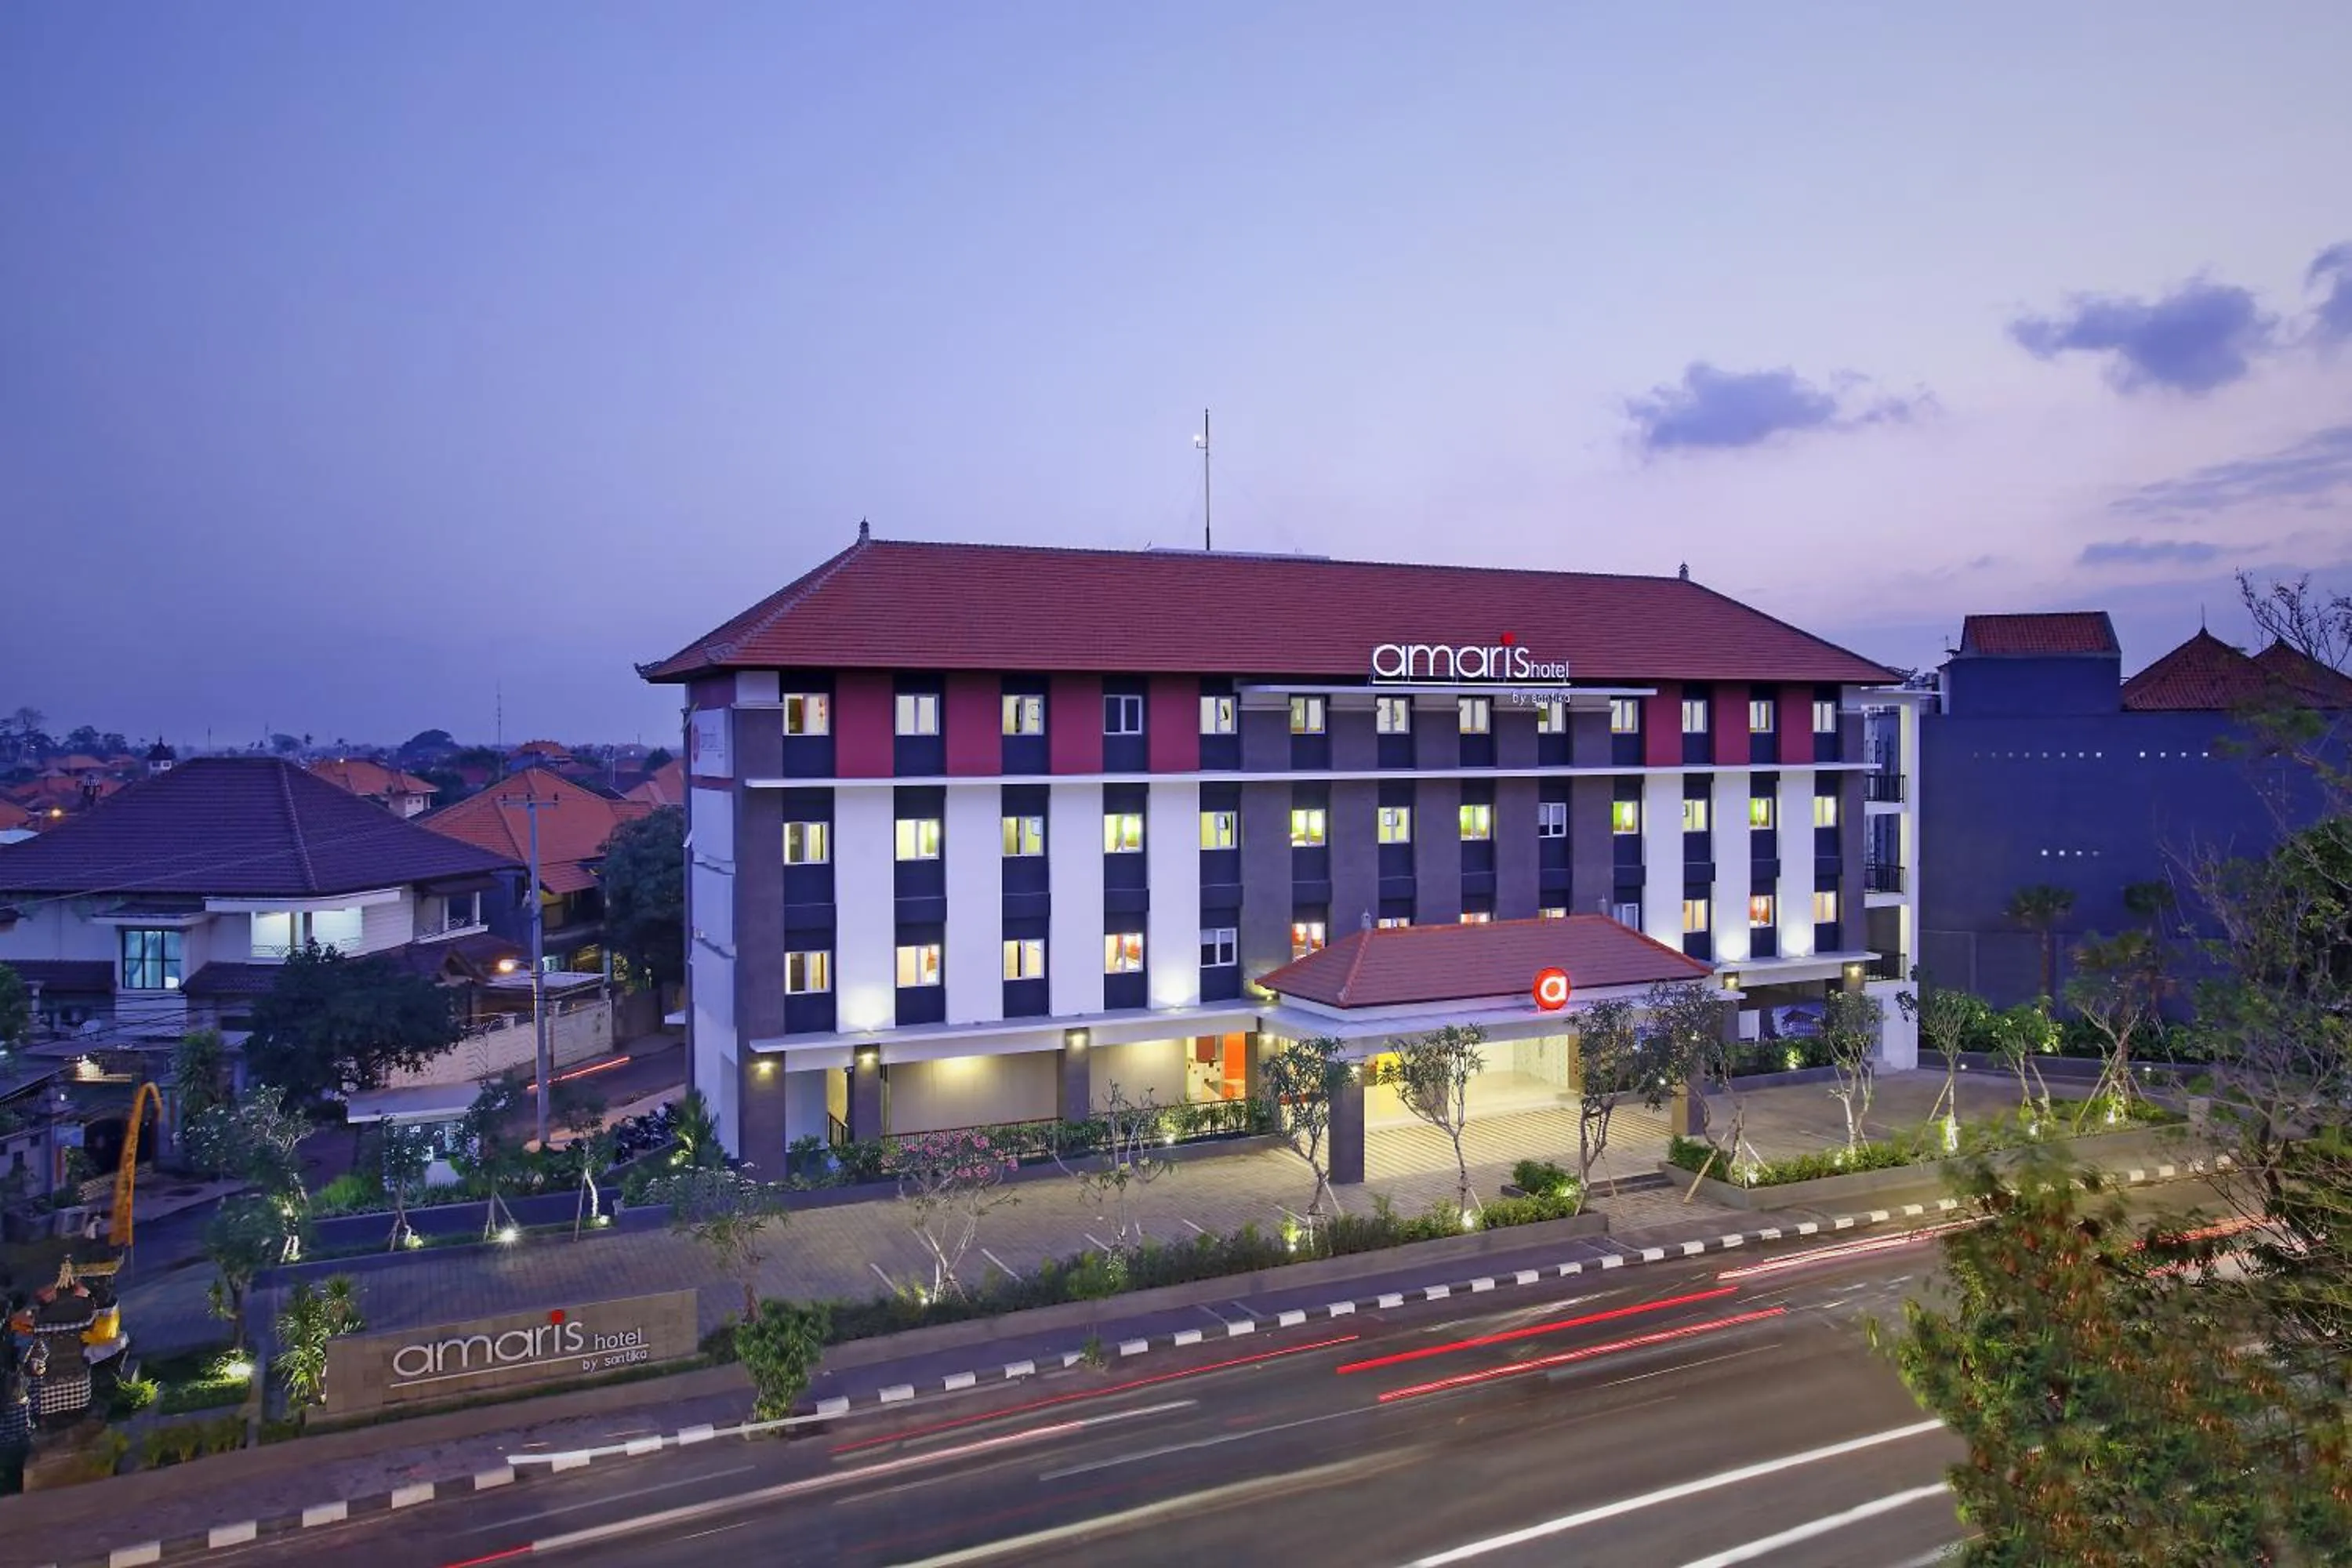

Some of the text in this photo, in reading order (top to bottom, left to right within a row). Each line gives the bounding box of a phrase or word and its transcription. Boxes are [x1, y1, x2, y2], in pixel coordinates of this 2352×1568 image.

[1373, 631, 1569, 678] amaris hotel
[1512, 691, 1526, 706] by
[393, 1309, 642, 1377] amaris hotel
[583, 1349, 648, 1374] by santika
